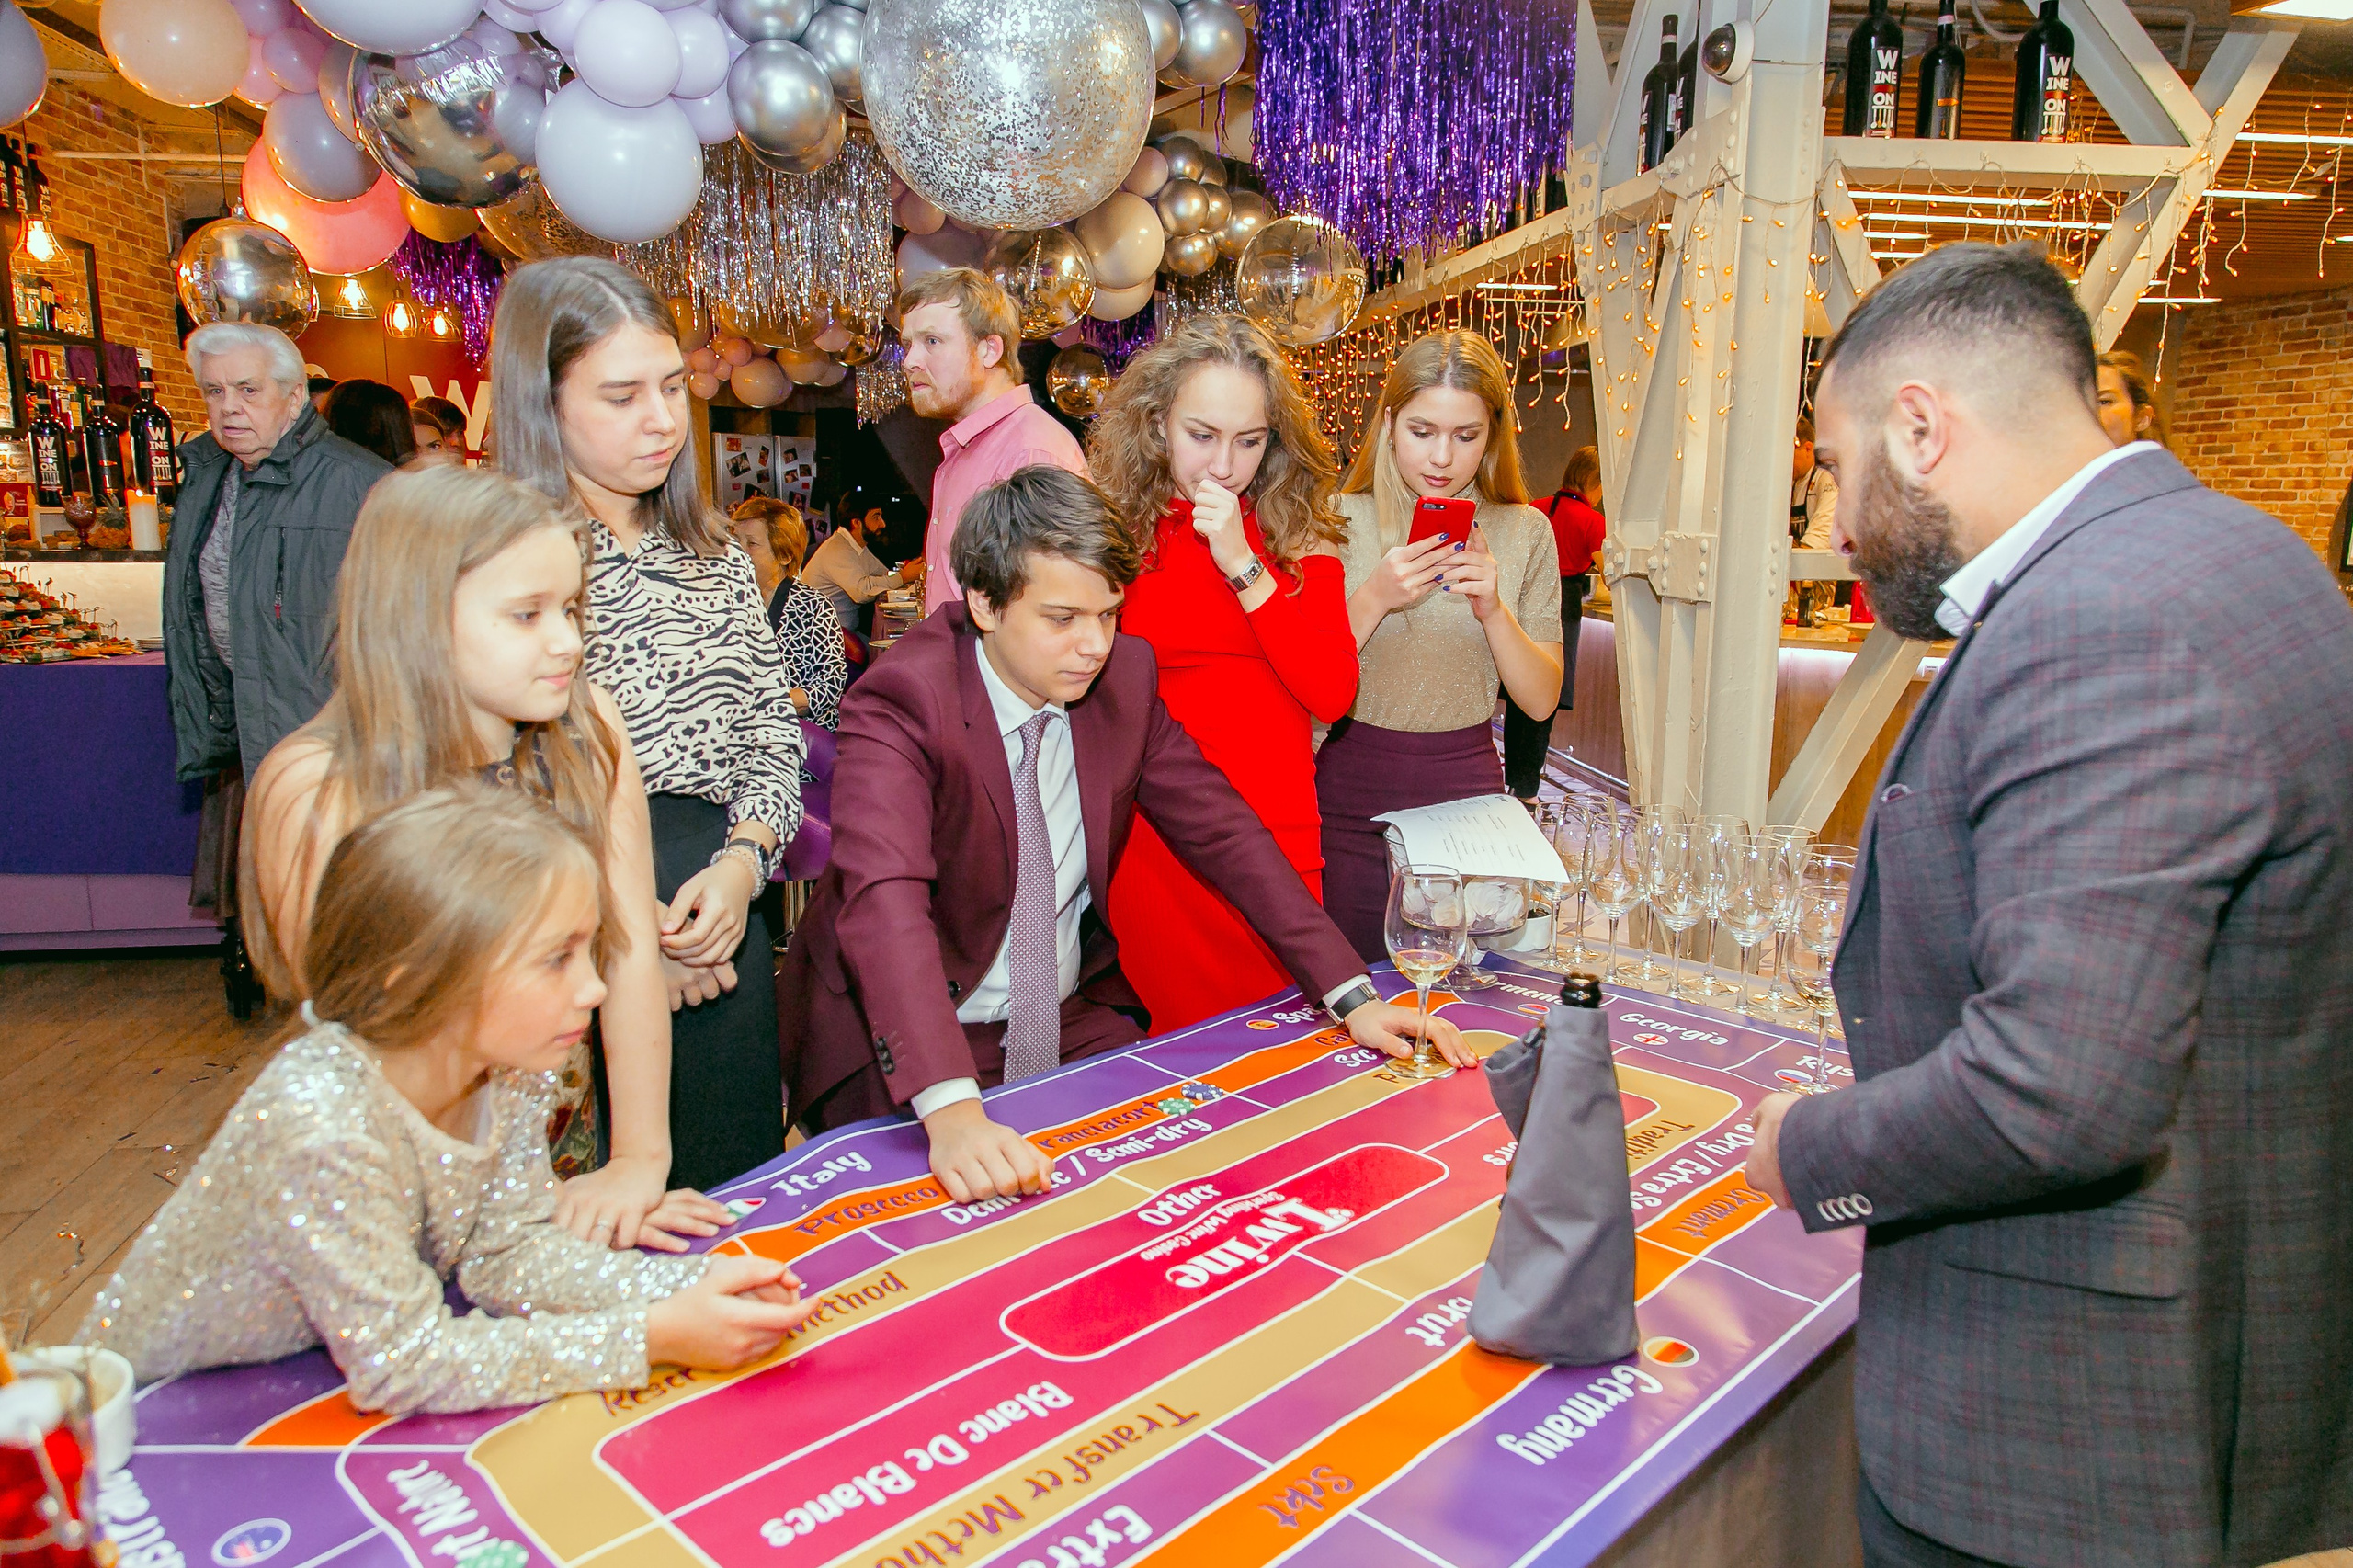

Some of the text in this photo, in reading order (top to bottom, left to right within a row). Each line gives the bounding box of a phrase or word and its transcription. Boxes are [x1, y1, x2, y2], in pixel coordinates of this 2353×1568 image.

[1877, 49, 1899, 70] W
[2049, 56, 2071, 77] W
[1874, 70, 1898, 85] INE
[2046, 77, 2069, 91] INE
[1872, 92, 1895, 106] ON
[2044, 98, 2066, 112] ON
[37, 437, 55, 449] W
[148, 426, 166, 441] W
[149, 441, 169, 450] INE
[39, 449, 57, 458] INE
[40, 462, 58, 471] ON
[152, 455, 170, 465] ON
[1619, 1012, 1729, 1047] Georgia
[1334, 1049, 1378, 1068] Sec
[1038, 1101, 1158, 1149] ranciacort
[1085, 1115, 1213, 1165] Semi-dry
[769, 1149, 872, 1197] Italy
[1640, 1157, 1712, 1193] Extra
[793, 1187, 939, 1237] Prosecco
[1137, 1183, 1222, 1226] Other
[1672, 1188, 1766, 1239] Cremant
[1185, 1214, 1229, 1240] Wine
[1140, 1235, 1192, 1261] Casino
[1165, 1197, 1351, 1289] Lwine
[1495, 1364, 1664, 1466] Germany
[759, 1380, 1074, 1548] Blanc De Blancs
[1023, 1403, 1200, 1501] Transfer
[1257, 1465, 1356, 1529] Sekt
